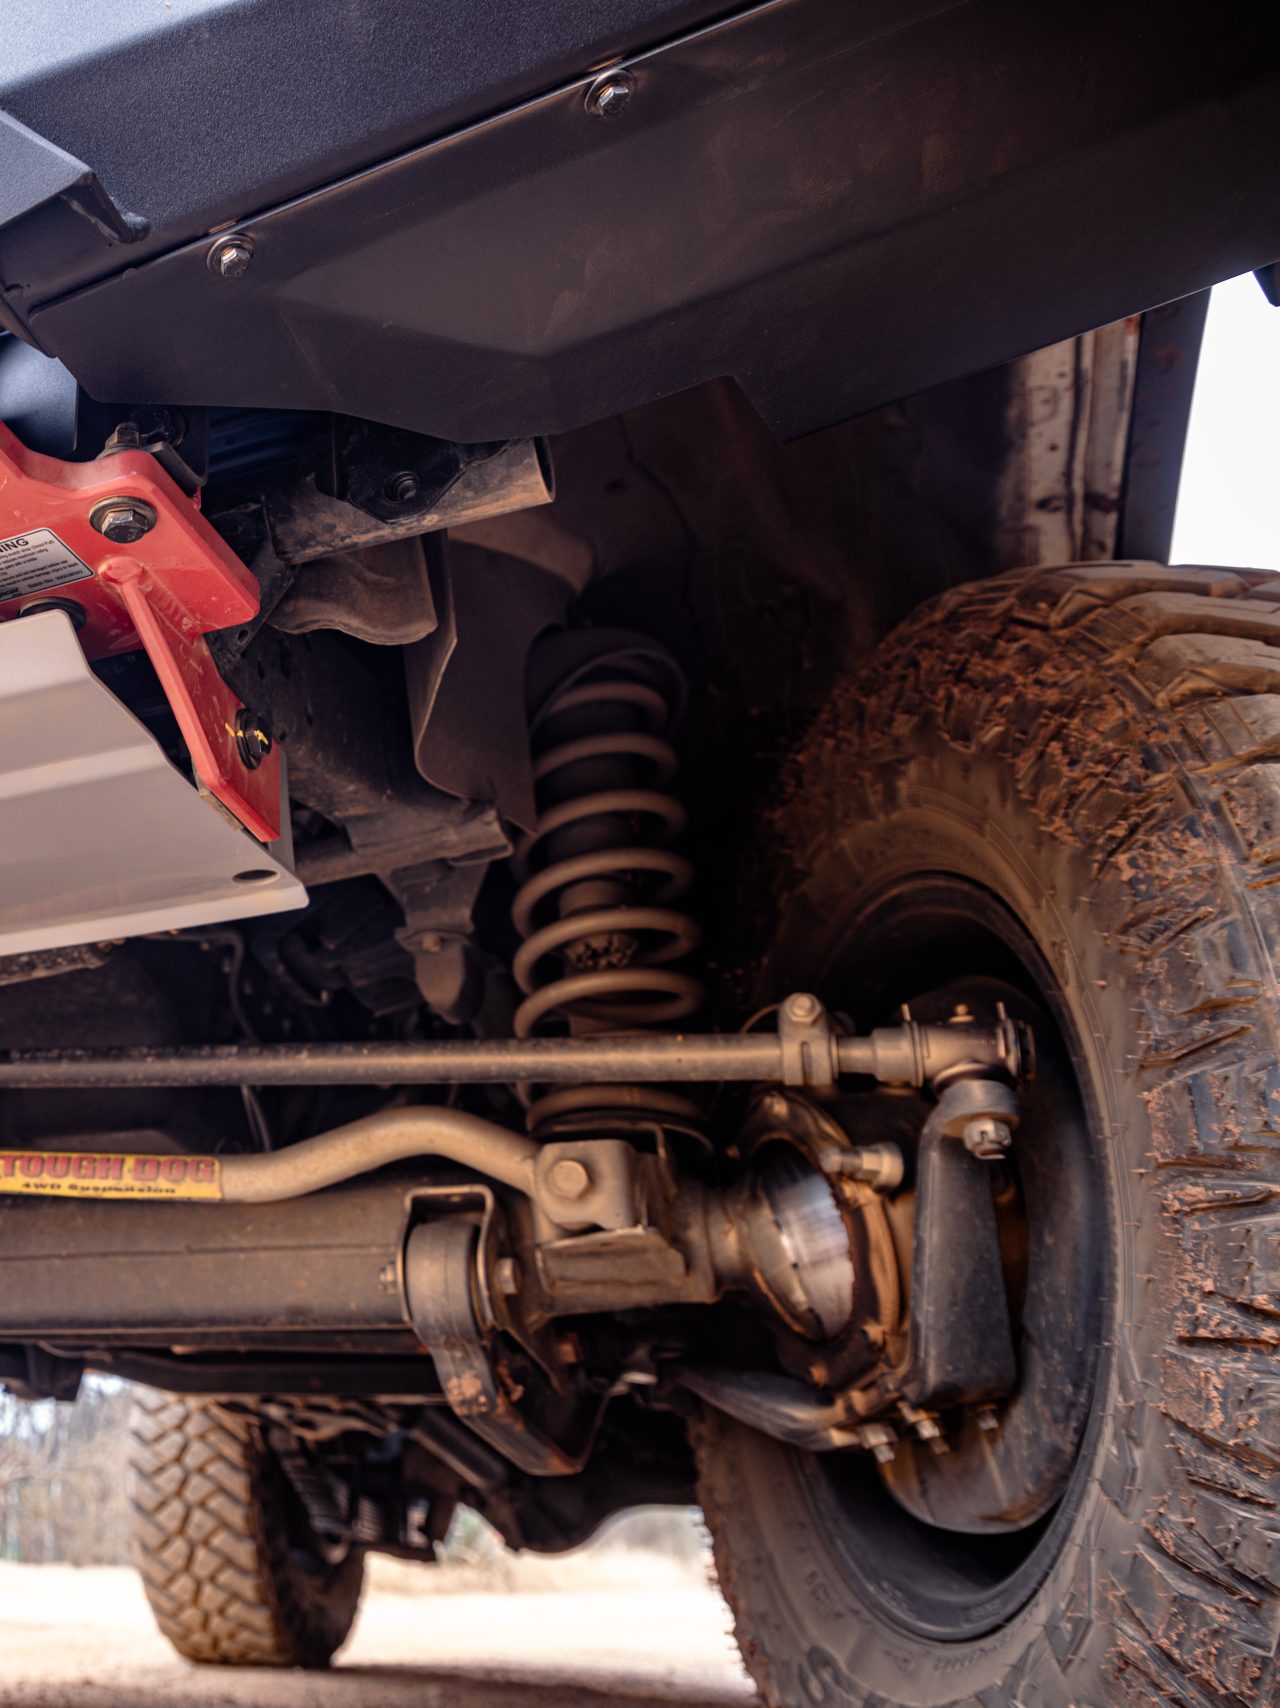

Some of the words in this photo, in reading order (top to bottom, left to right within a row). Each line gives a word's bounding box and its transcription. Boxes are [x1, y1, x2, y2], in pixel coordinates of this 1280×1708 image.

[131, 1157, 216, 1183] DOG
[22, 1182, 62, 1190] 4WD
[68, 1183, 176, 1194] Suspension
